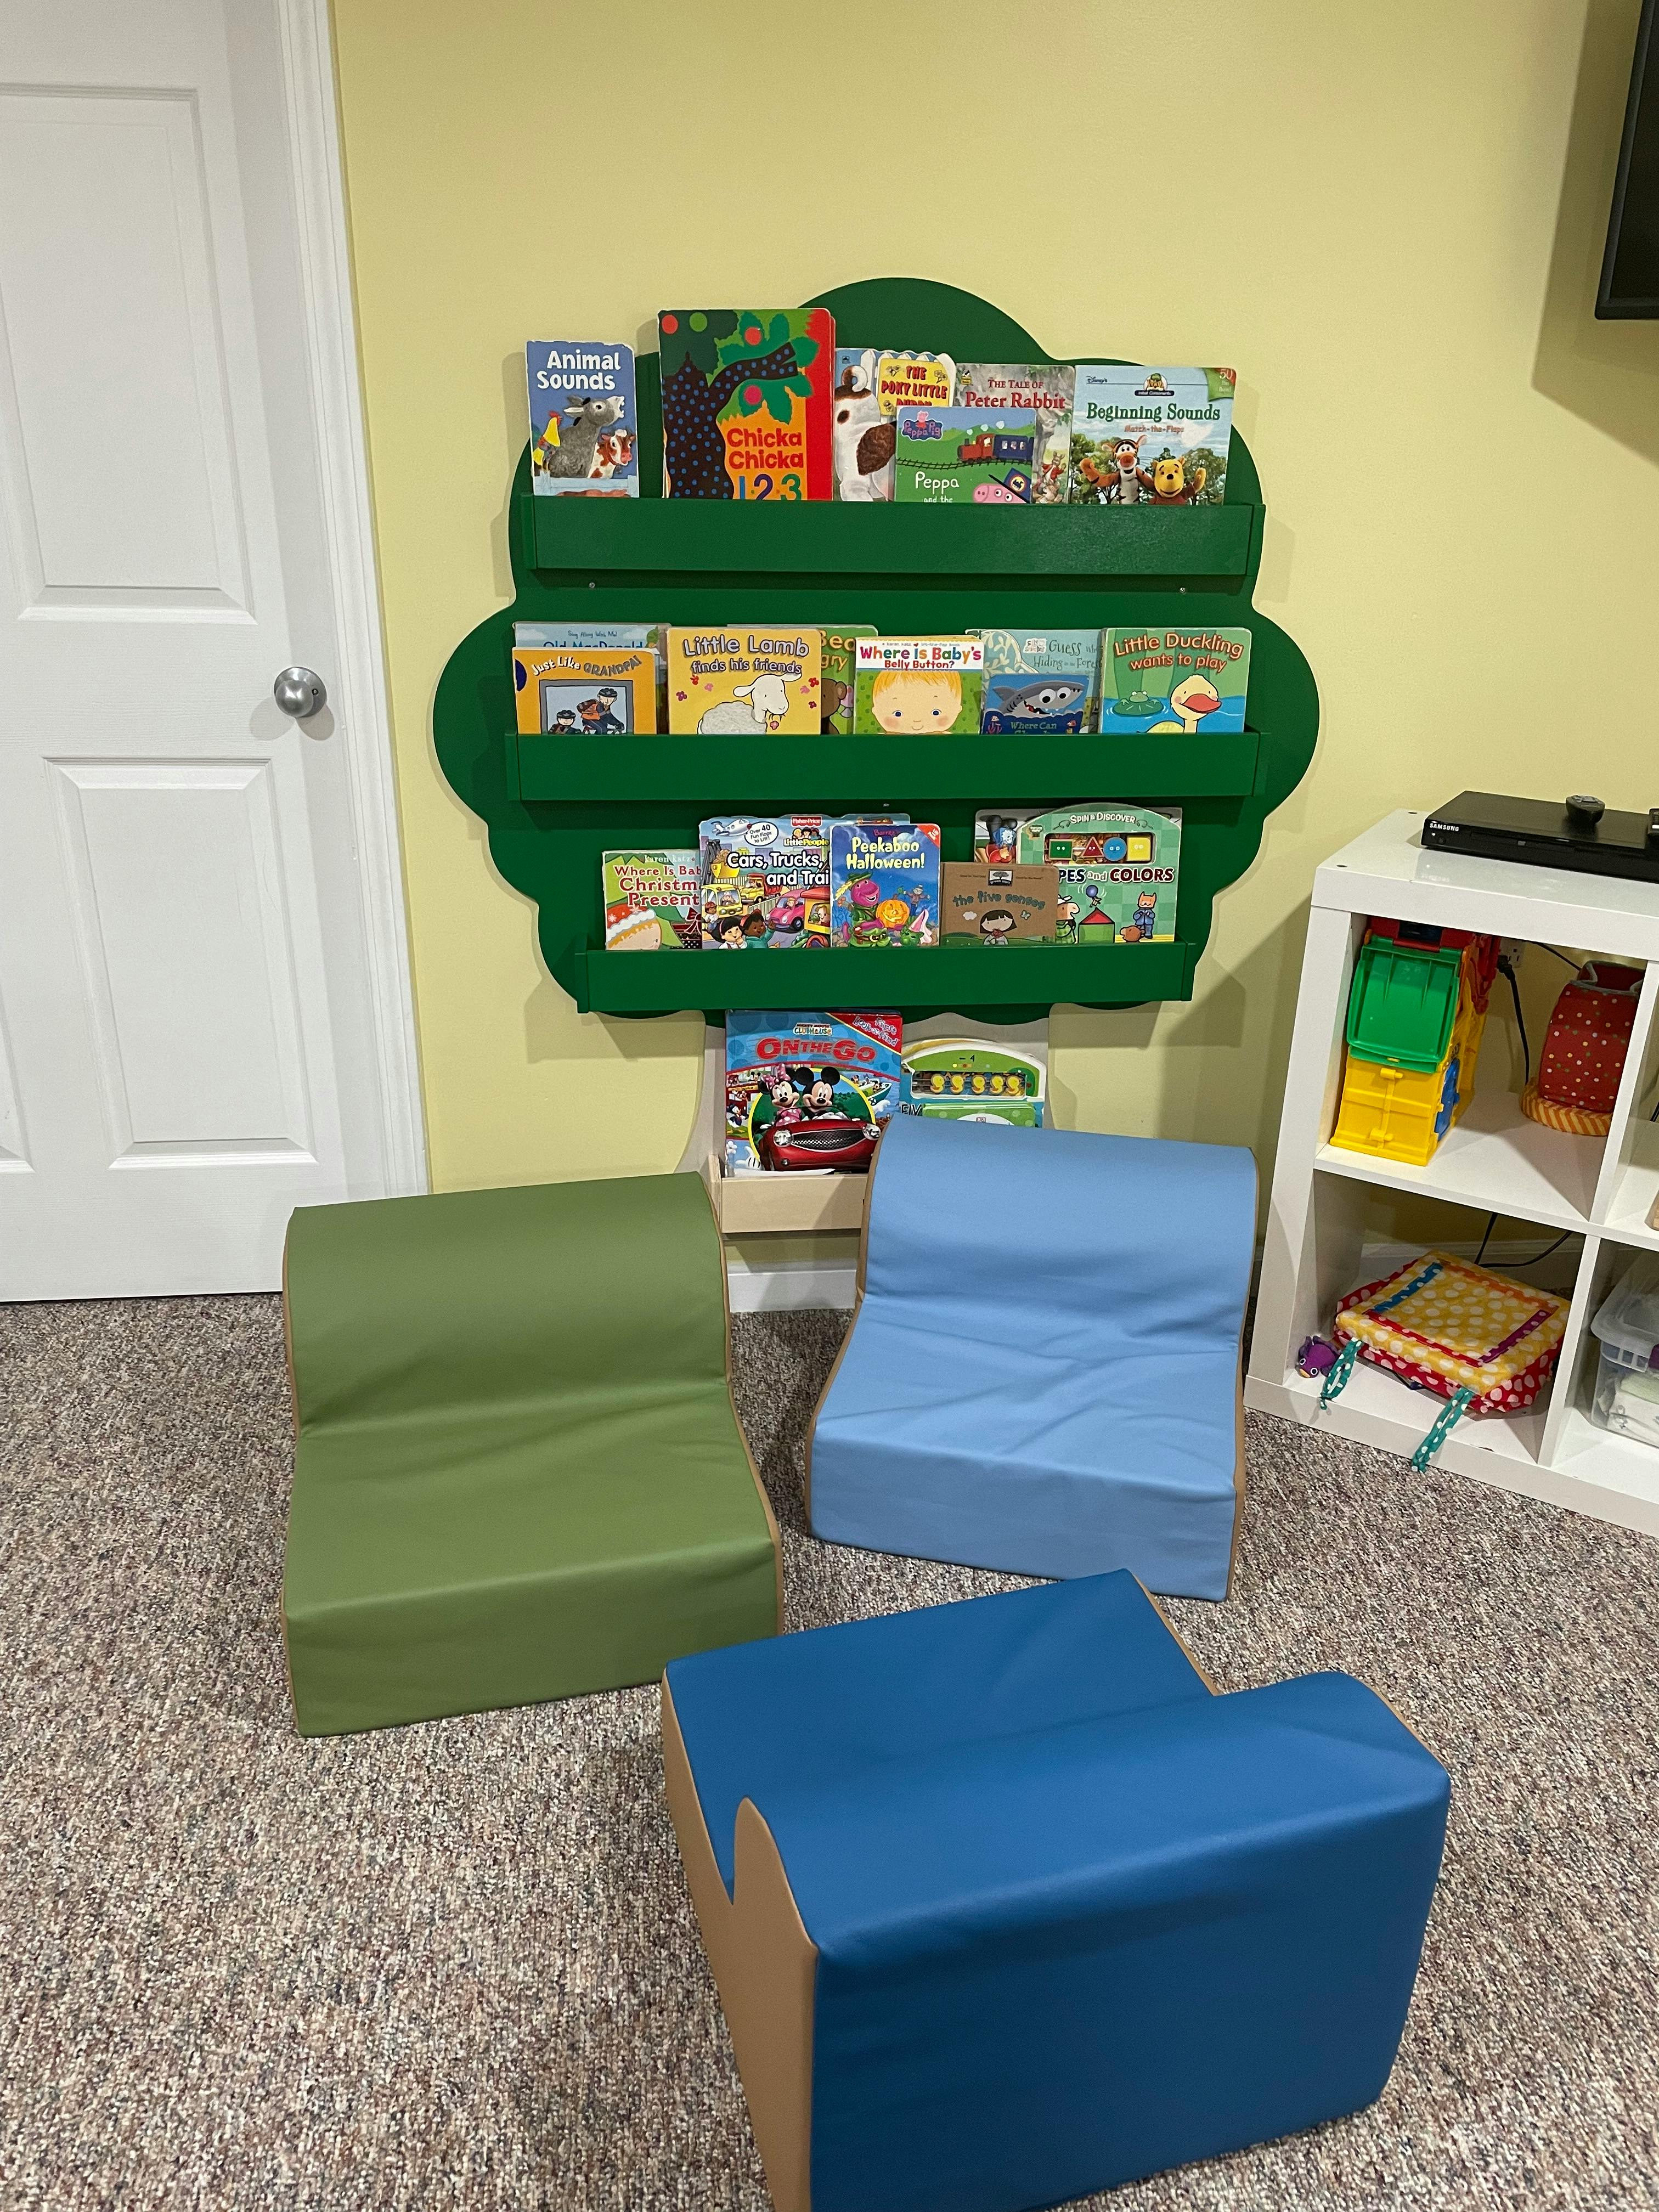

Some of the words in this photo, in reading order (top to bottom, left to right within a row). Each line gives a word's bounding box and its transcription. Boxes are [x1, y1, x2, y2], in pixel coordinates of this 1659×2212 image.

[546, 349, 621, 370] Animal
[537, 370, 616, 390] Sounds
[905, 365, 927, 380] THE
[882, 380, 911, 396] POKY
[912, 382, 948, 399] LITTLE
[988, 379, 1006, 388] THE
[1008, 380, 1030, 388] TALE
[964, 391, 1008, 408] Peter
[1010, 392, 1065, 409] Rabbit
[1086, 402, 1162, 422] Beginning
[1167, 403, 1220, 420] Sounds
[726, 427, 802, 448] Chicka
[904, 421, 928, 438] Peppa
[729, 449, 804, 470] Chicka
[915, 471, 960, 495] Peppa
[684, 635, 740, 657] Little
[749, 635, 809, 657] Lamb
[860, 646, 910, 659] Where
[932, 646, 981, 664] Baby's
[1049, 640, 1081, 656] Guess
[1114, 635, 1159, 656] Little
[1166, 633, 1244, 659] Duckling
[531, 658, 556, 676] Just
[557, 656, 581, 670] Like
[583, 654, 643, 676] GRANDPA!
[692, 658, 726, 674] finds
[729, 658, 749, 670] his
[754, 658, 802, 674] friends
[884, 659, 910, 670] Belly
[913, 660, 955, 668] Button?
[1034, 655, 1063, 670] Hiding
[1130, 653, 1173, 670] wants
[1178, 653, 1192, 665] to
[1196, 654, 1227, 673] play
[1070, 815, 1090, 823] SPIN
[1097, 812, 1136, 823] DISCOVER
[1430, 823, 1459, 832] SAMSUNG
[852, 837, 919, 853] Peekaboo
[727, 852, 768, 869] Cars,
[770, 851, 823, 868] Trucks,
[846, 853, 925, 870] Halloween!
[614, 866, 659, 876] Where
[664, 865, 674, 876] Is
[766, 870, 797, 885] and
[1087, 871, 1107, 881] and
[1110, 868, 1173, 882] COLORS
[953, 894, 974, 907] the
[978, 890, 1001, 903] five
[1005, 894, 1046, 910] senses
